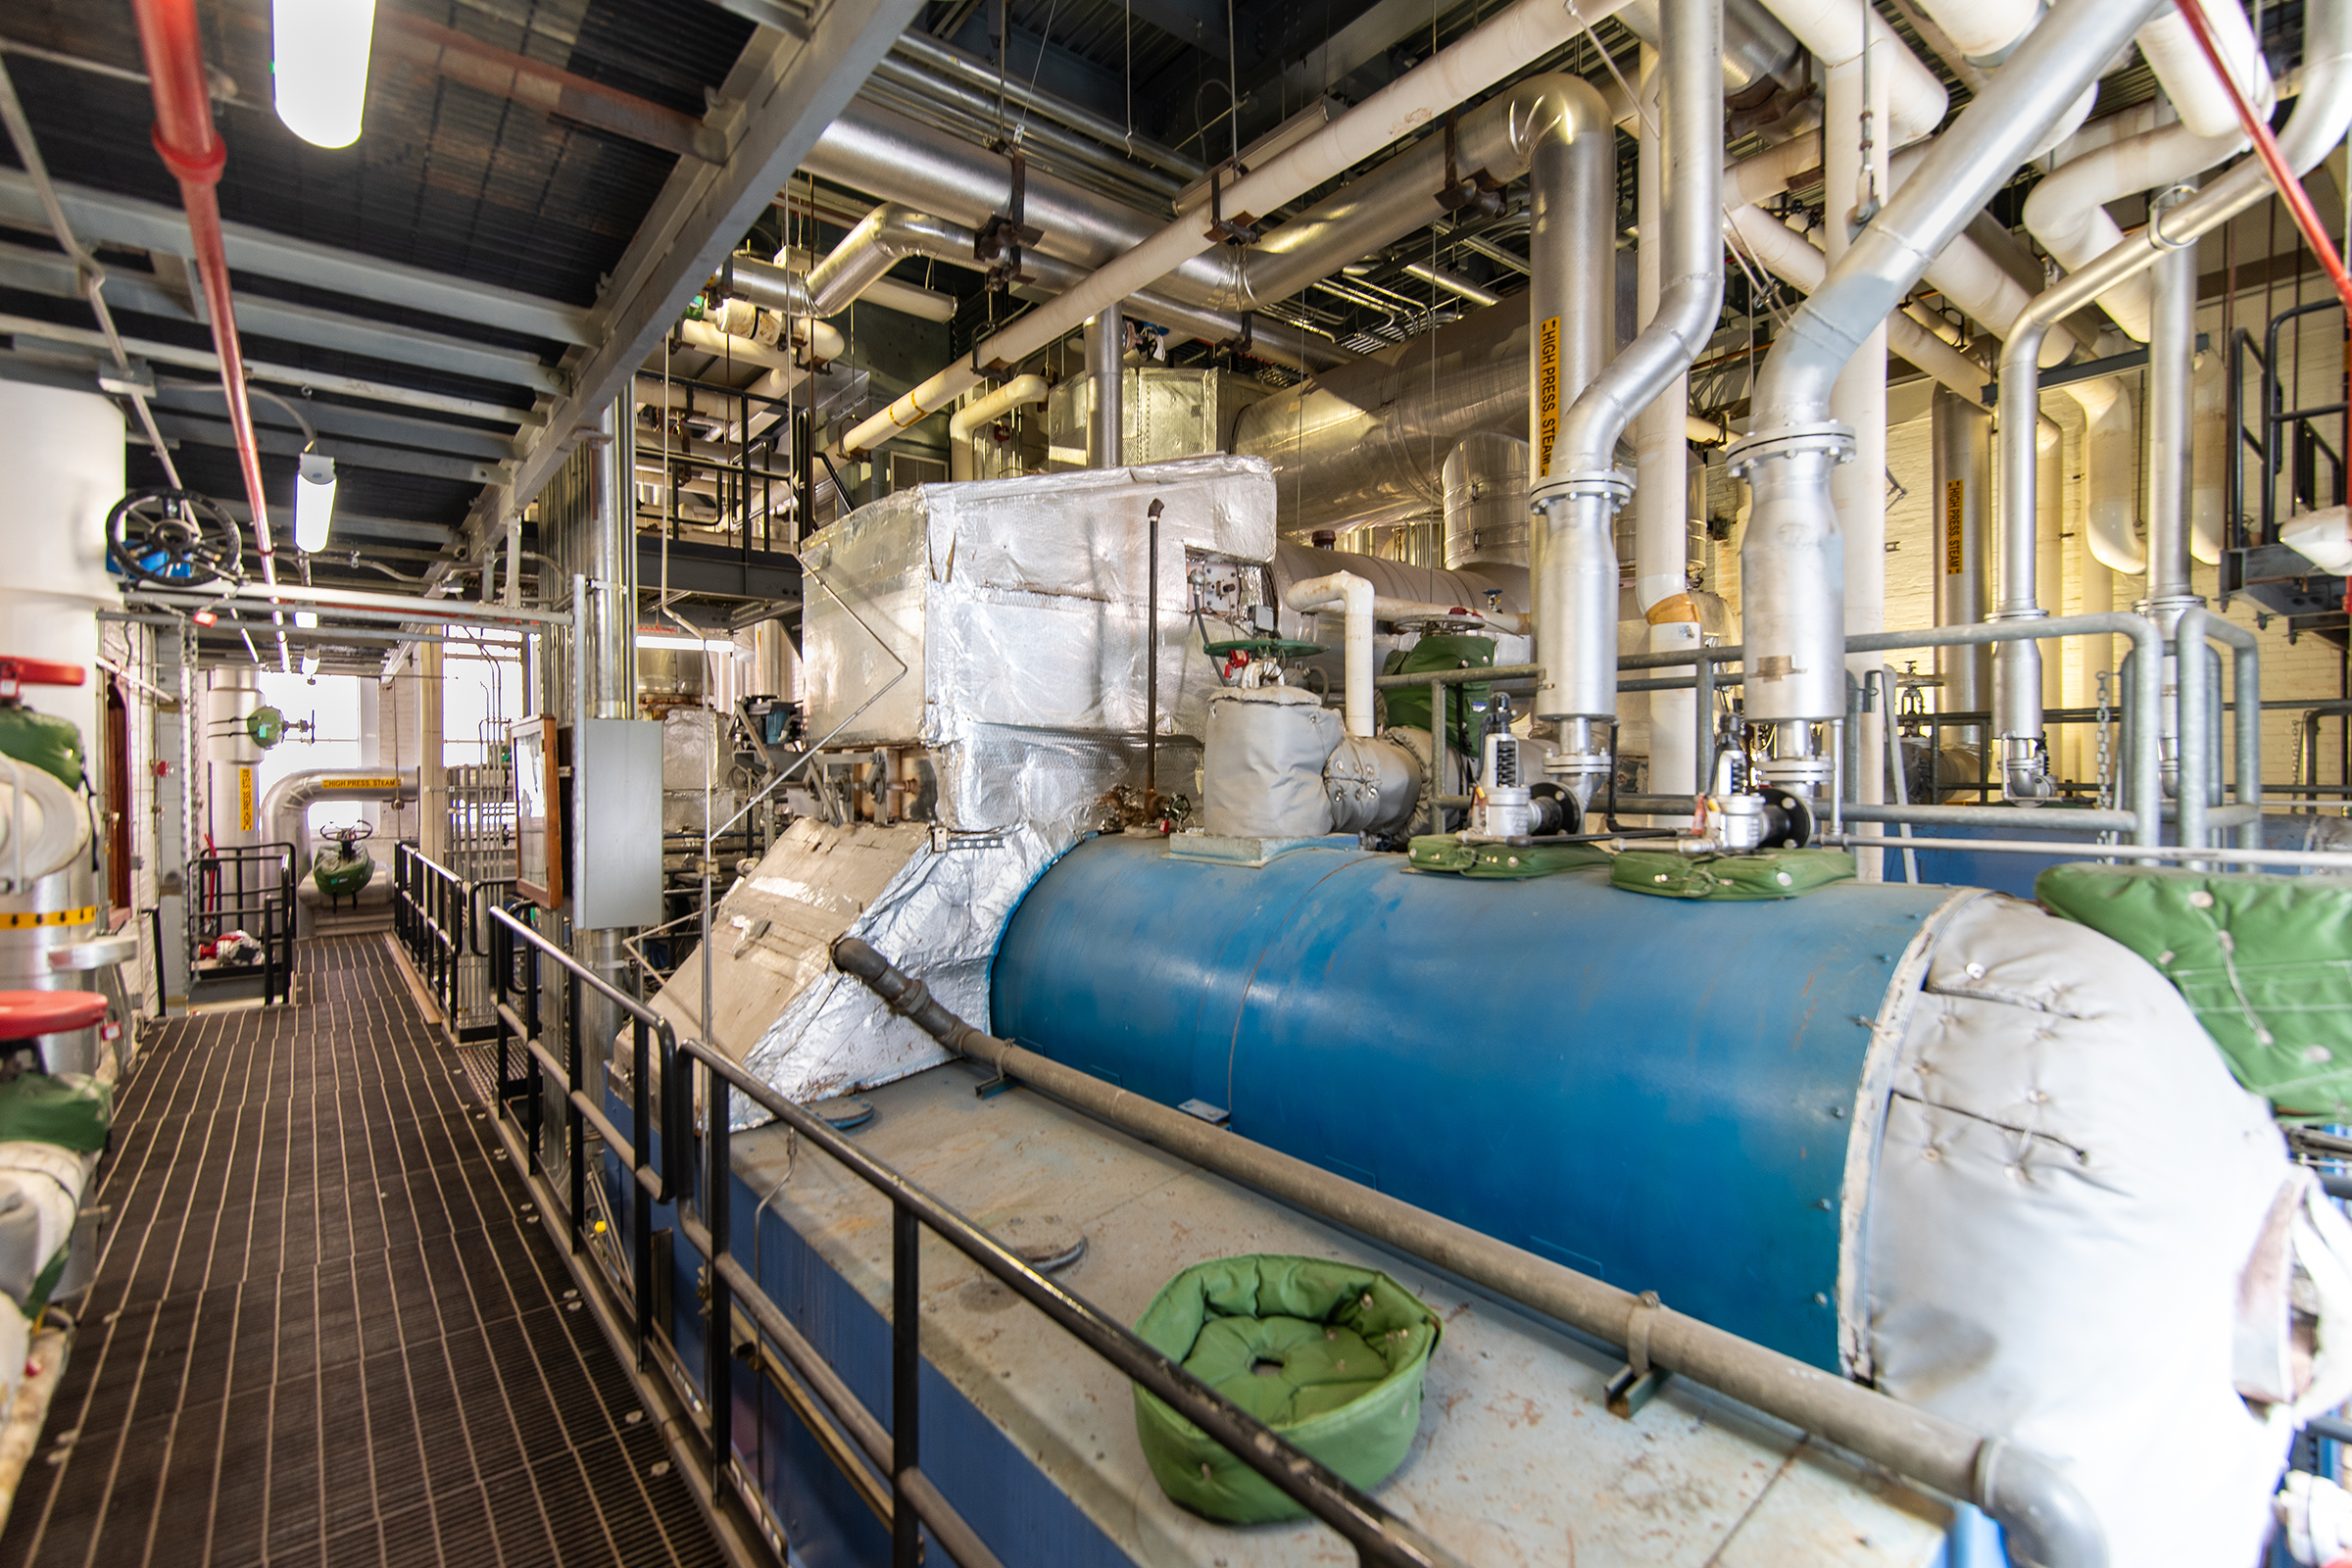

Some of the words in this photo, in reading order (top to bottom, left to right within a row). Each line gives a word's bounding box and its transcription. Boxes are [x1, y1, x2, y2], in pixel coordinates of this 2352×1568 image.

[1543, 330, 1555, 366] HIGH
[1543, 367, 1555, 416] PRESS.
[1543, 418, 1555, 466] STEAM
[1949, 487, 1960, 509] HIGH
[1949, 540, 1960, 567] STEAM
